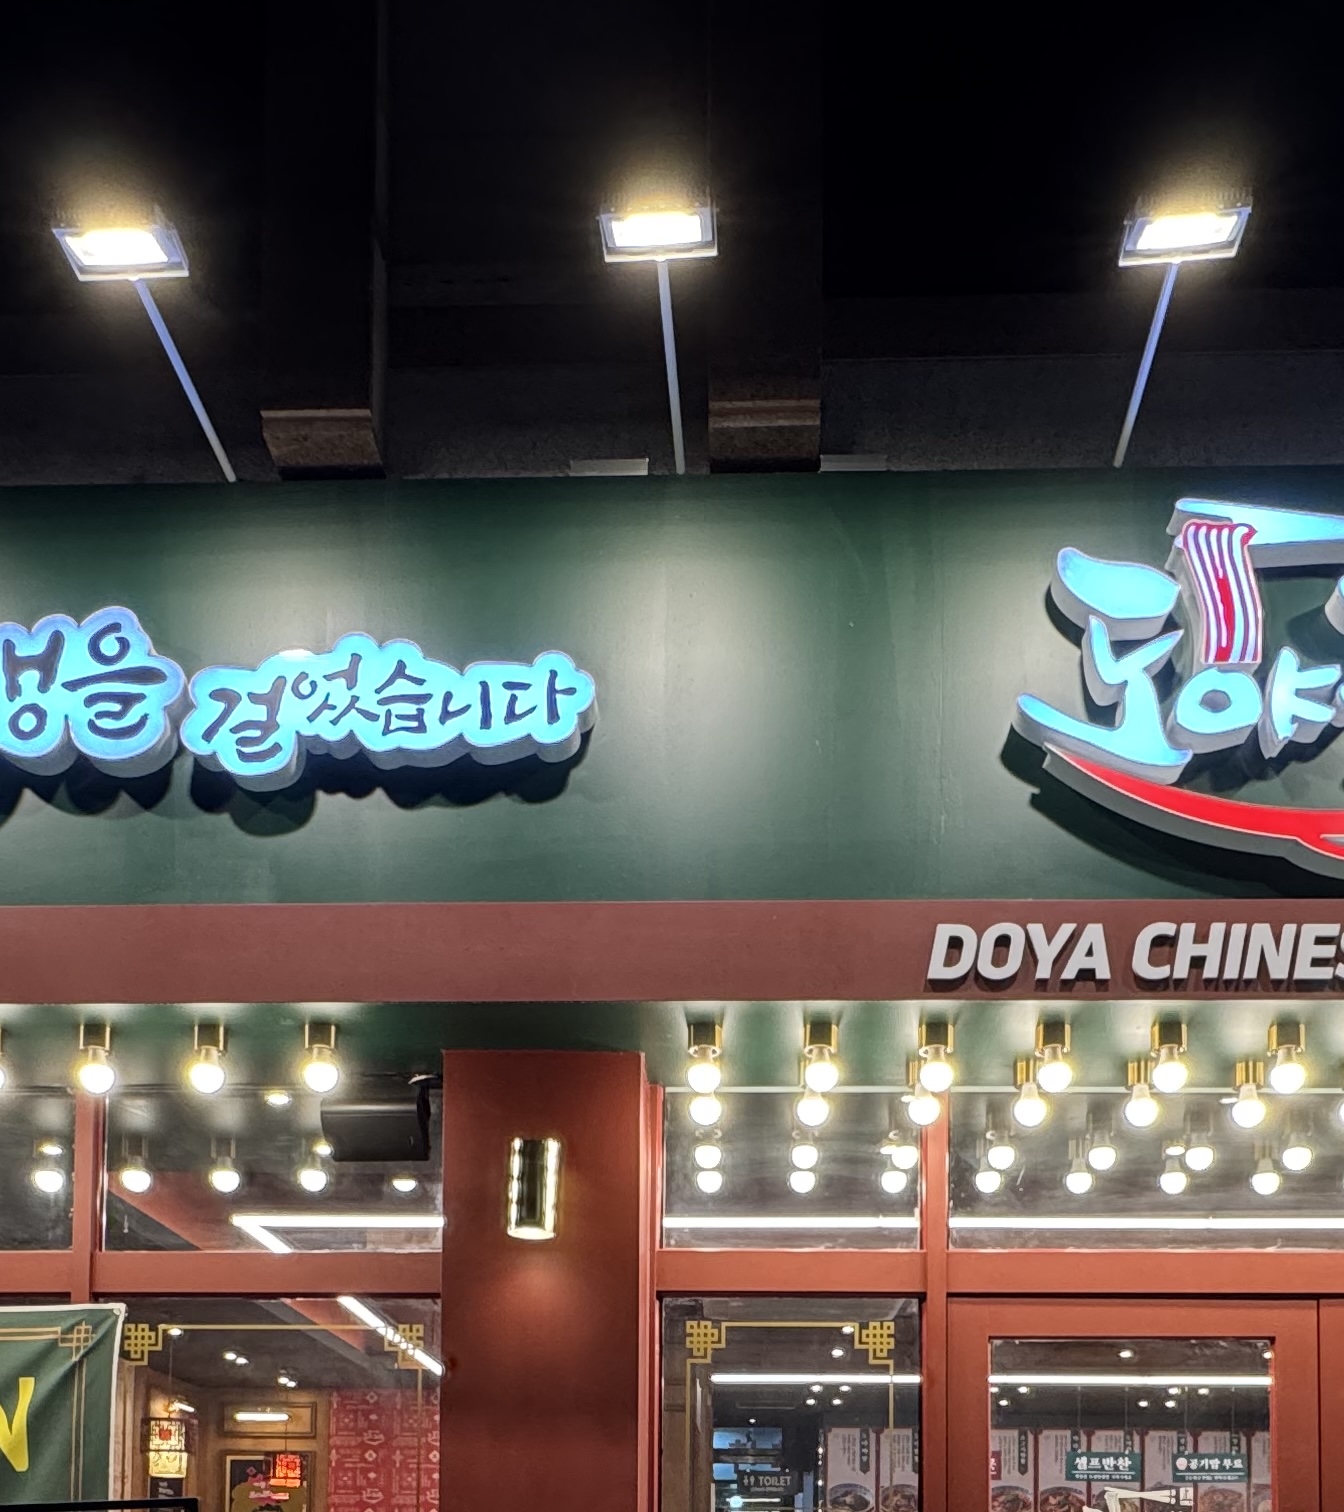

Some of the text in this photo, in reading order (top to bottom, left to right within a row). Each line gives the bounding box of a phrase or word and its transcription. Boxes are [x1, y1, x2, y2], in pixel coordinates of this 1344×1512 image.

[201, 652, 579, 765] 걸었습니다
[927, 922, 1112, 983] DOYA
[758, 1475, 792, 1487] TOILET
